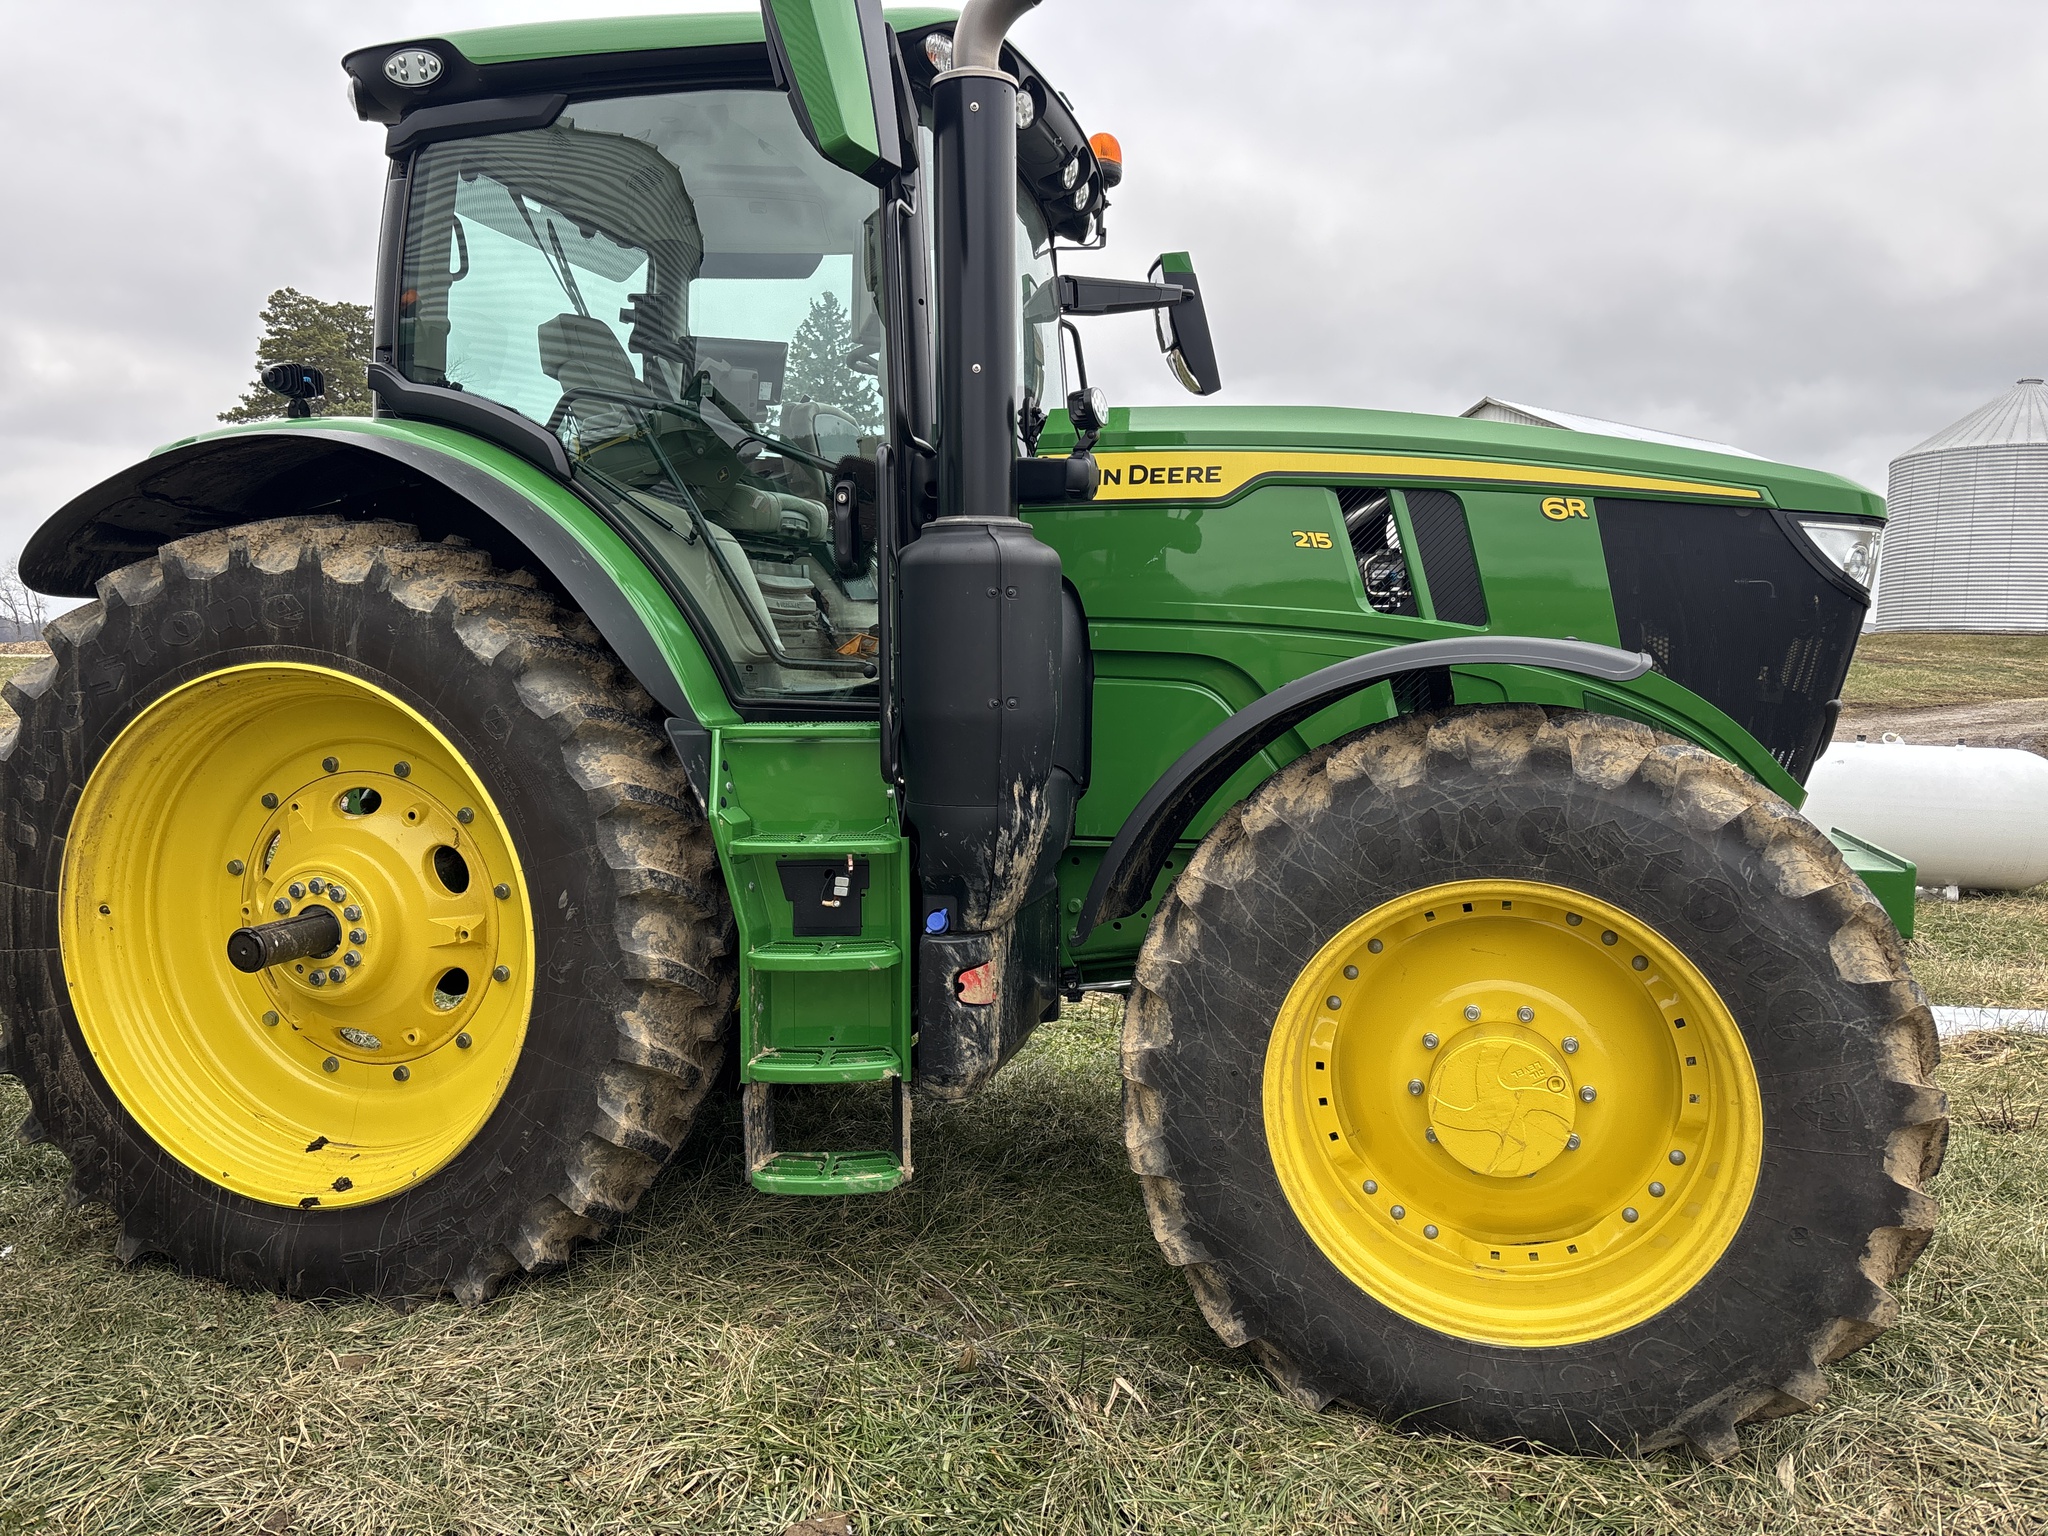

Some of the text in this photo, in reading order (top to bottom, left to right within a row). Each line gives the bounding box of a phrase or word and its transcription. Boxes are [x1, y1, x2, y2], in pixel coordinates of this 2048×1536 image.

[1129, 465, 1222, 485] DEERE
[1540, 496, 1590, 522] 6R
[1291, 530, 1333, 550] 215
[1510, 1060, 1542, 1079] LEVEL
[1529, 1068, 1546, 1080] OIL
